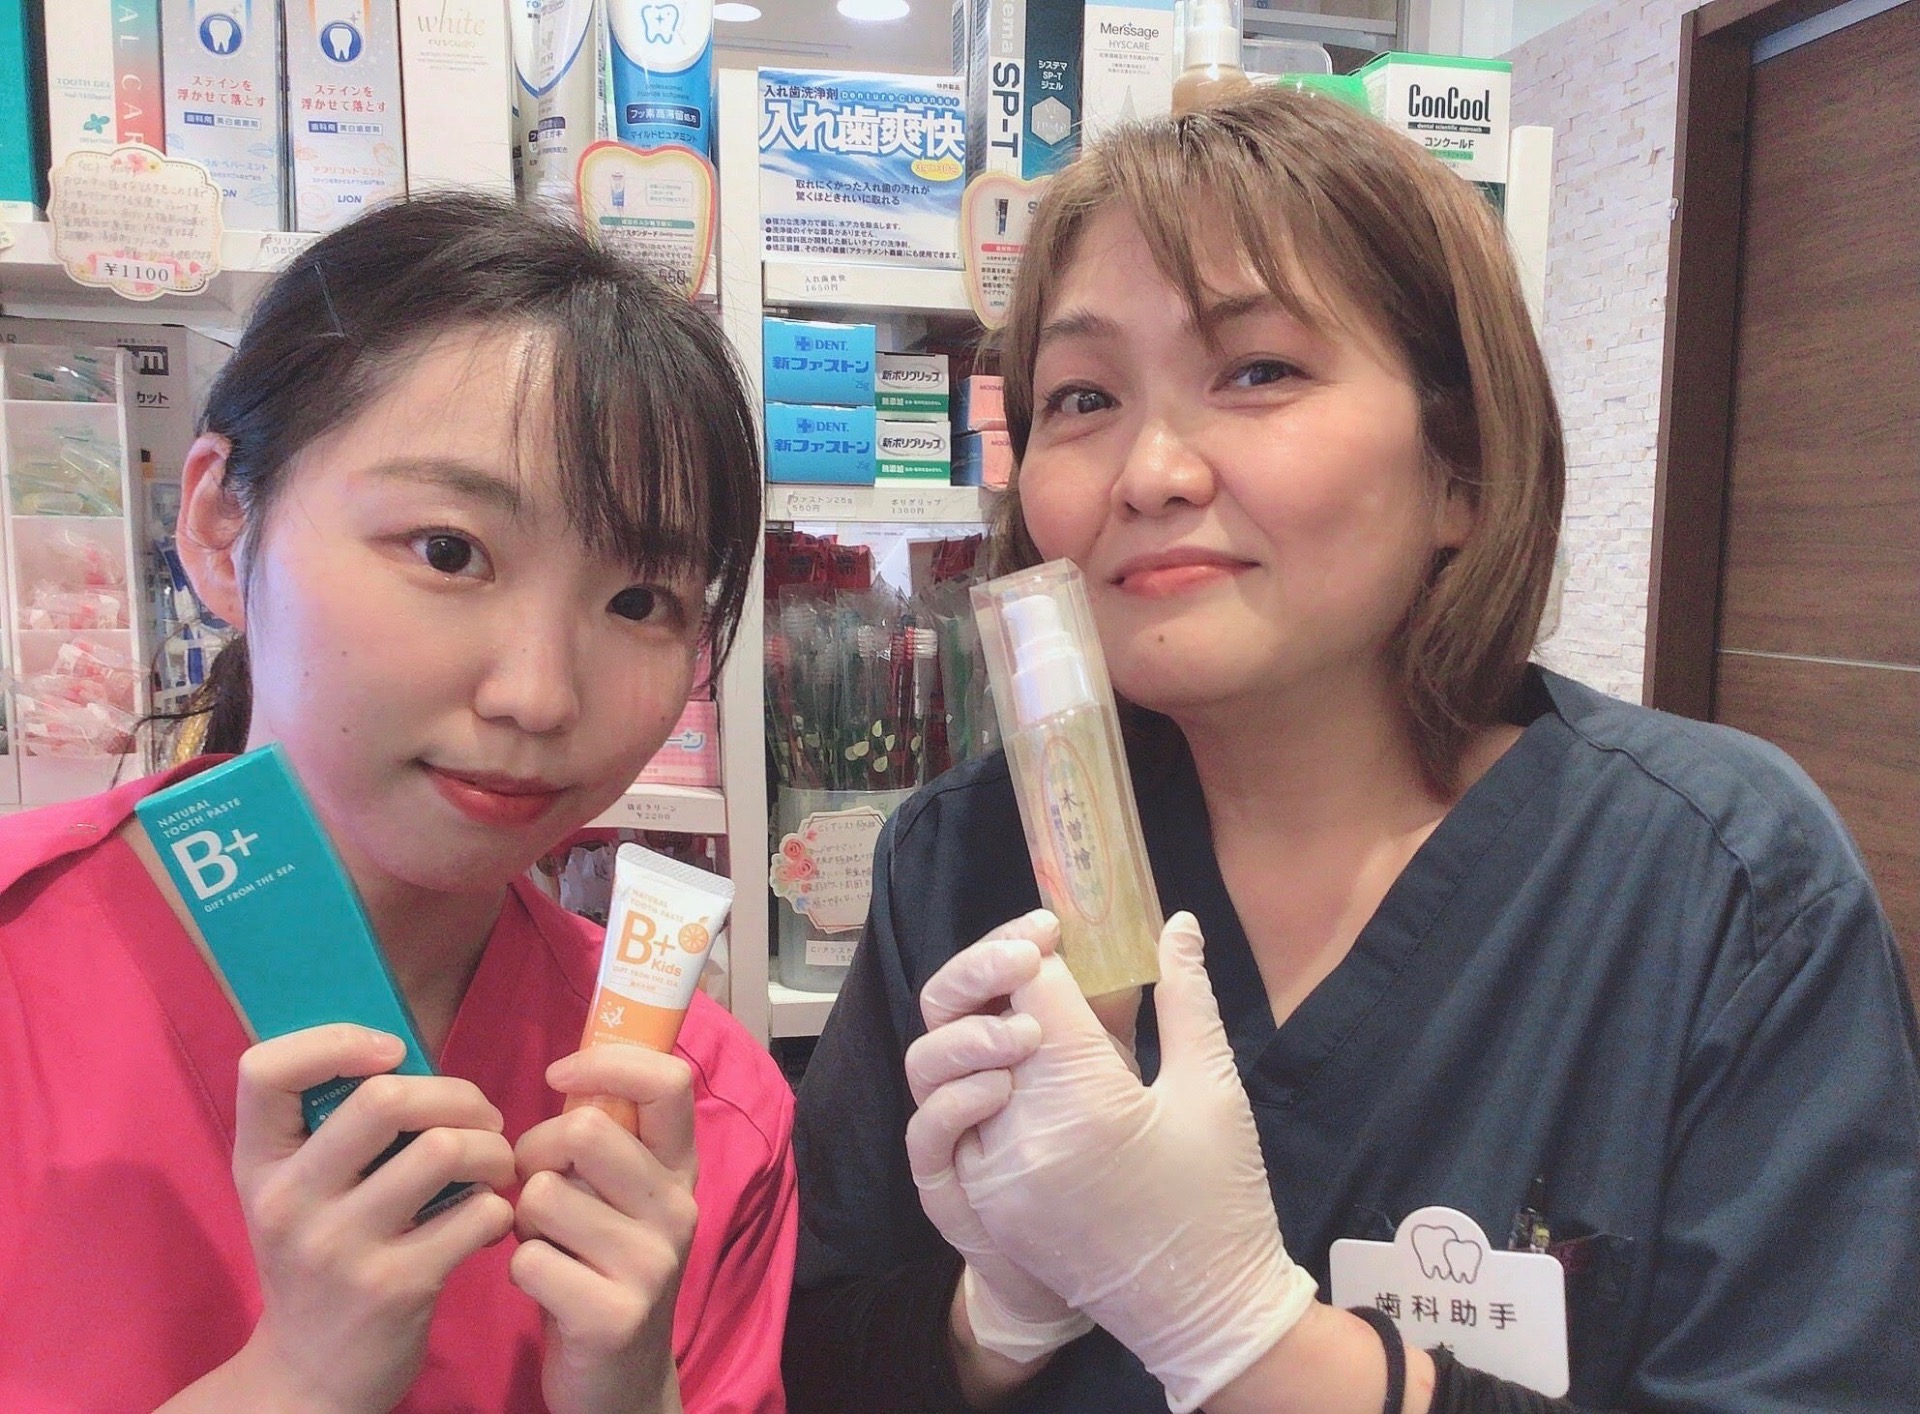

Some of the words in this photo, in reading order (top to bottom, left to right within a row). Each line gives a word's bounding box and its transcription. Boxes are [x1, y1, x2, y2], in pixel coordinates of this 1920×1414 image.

[1100, 22, 1159, 40] Merssage
[1108, 40, 1150, 51] HYSCARE
[1038, 59, 1068, 71] システマ
[1042, 71, 1062, 79] SP-T
[191, 76, 252, 92] ステインを
[315, 84, 375, 98] ステインを
[1041, 80, 1064, 90] ジェル
[177, 88, 266, 108] 浮かせて落とす
[764, 85, 838, 100] 入れ歯洗浄剤
[840, 91, 898, 102] Denture
[899, 93, 960, 107] Cleanser
[301, 98, 387, 112] 浮かせて落とす
[991, 62, 1020, 158] SP-T
[1408, 84, 1491, 122] ConCool
[631, 130, 696, 142] マイルドピュアミント
[759, 99, 965, 162] 入れ歯爽快
[1424, 136, 1475, 149] コンクールF
[795, 179, 930, 195] 取れにくかった入れ歯の汚れが
[337, 194, 362, 203] LION
[796, 191, 900, 205] 驚くほどきれいに取れる
[104, 262, 169, 281] ¥1100
[772, 356, 869, 373] 新ファストン
[881, 369, 940, 382] 新ポリグリップ
[136, 391, 169, 404] カット
[774, 439, 870, 454] 新ファストン
[882, 437, 941, 451] 新ポリグリップ
[157, 798, 211, 827] NATURAL
[163, 815, 204, 839] TOOTH
[207, 797, 242, 819] PASTE
[170, 827, 259, 901] B+
[203, 899, 225, 914] GIFT
[226, 883, 256, 904] FROM
[255, 873, 277, 888] THE
[276, 862, 297, 879] SEA
[616, 909, 676, 965] B+
[650, 958, 682, 977] Kids
[1375, 1291, 1517, 1330] 歯科助手
